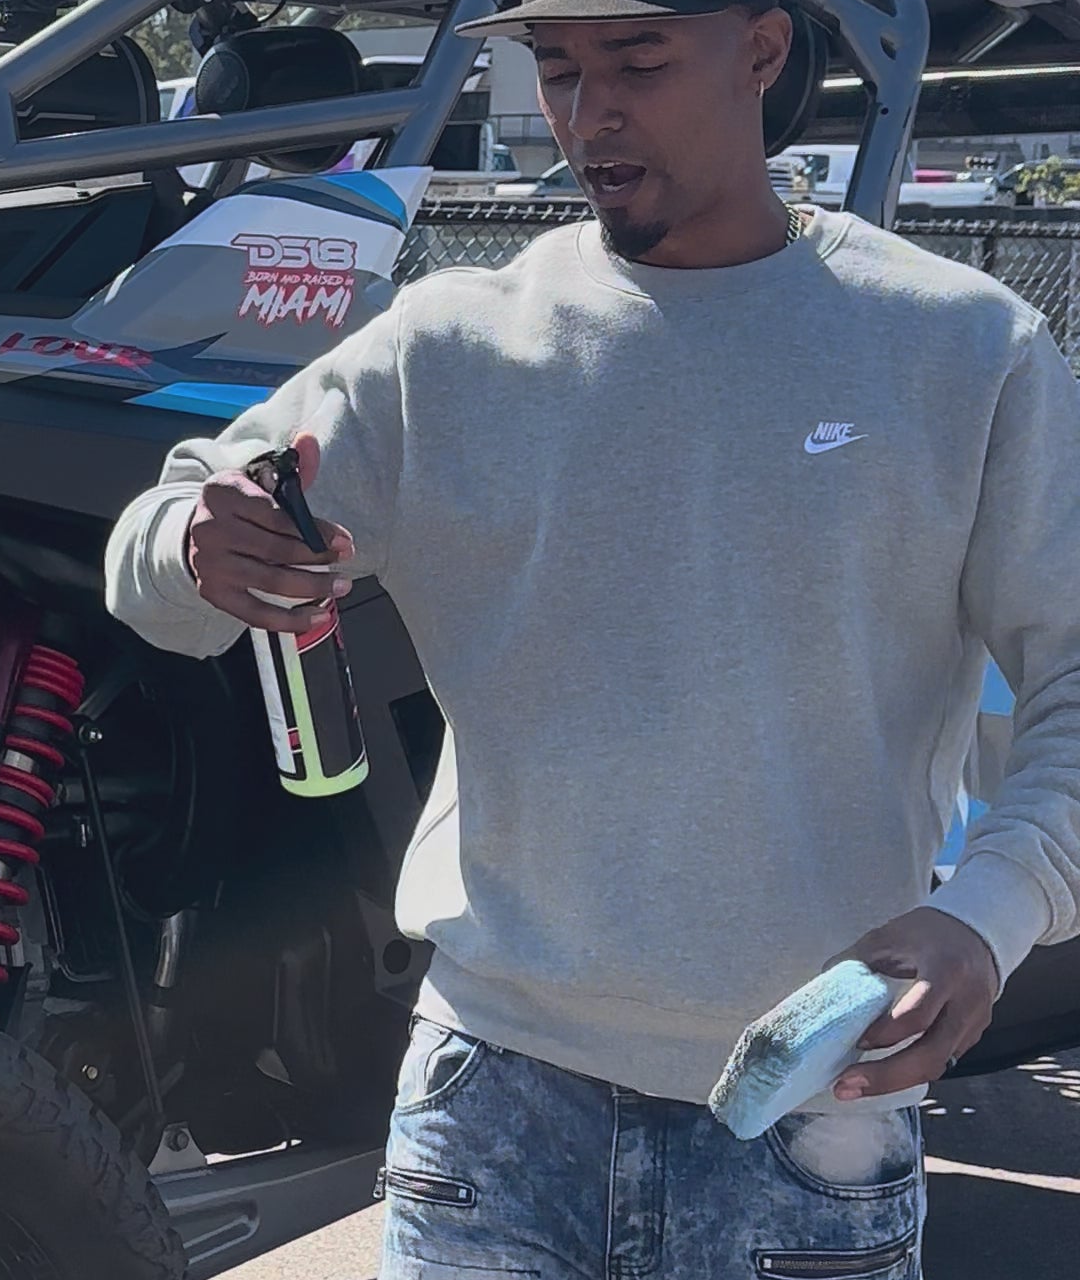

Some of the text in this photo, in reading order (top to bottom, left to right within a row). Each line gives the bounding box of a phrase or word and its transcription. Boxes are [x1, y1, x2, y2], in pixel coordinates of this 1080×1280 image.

[231, 233, 357, 270] DS18
[244, 271, 279, 284] BORN
[280, 274, 301, 285] AND
[238, 283, 353, 327] MIAMI
[813, 421, 854, 440] NIKE
